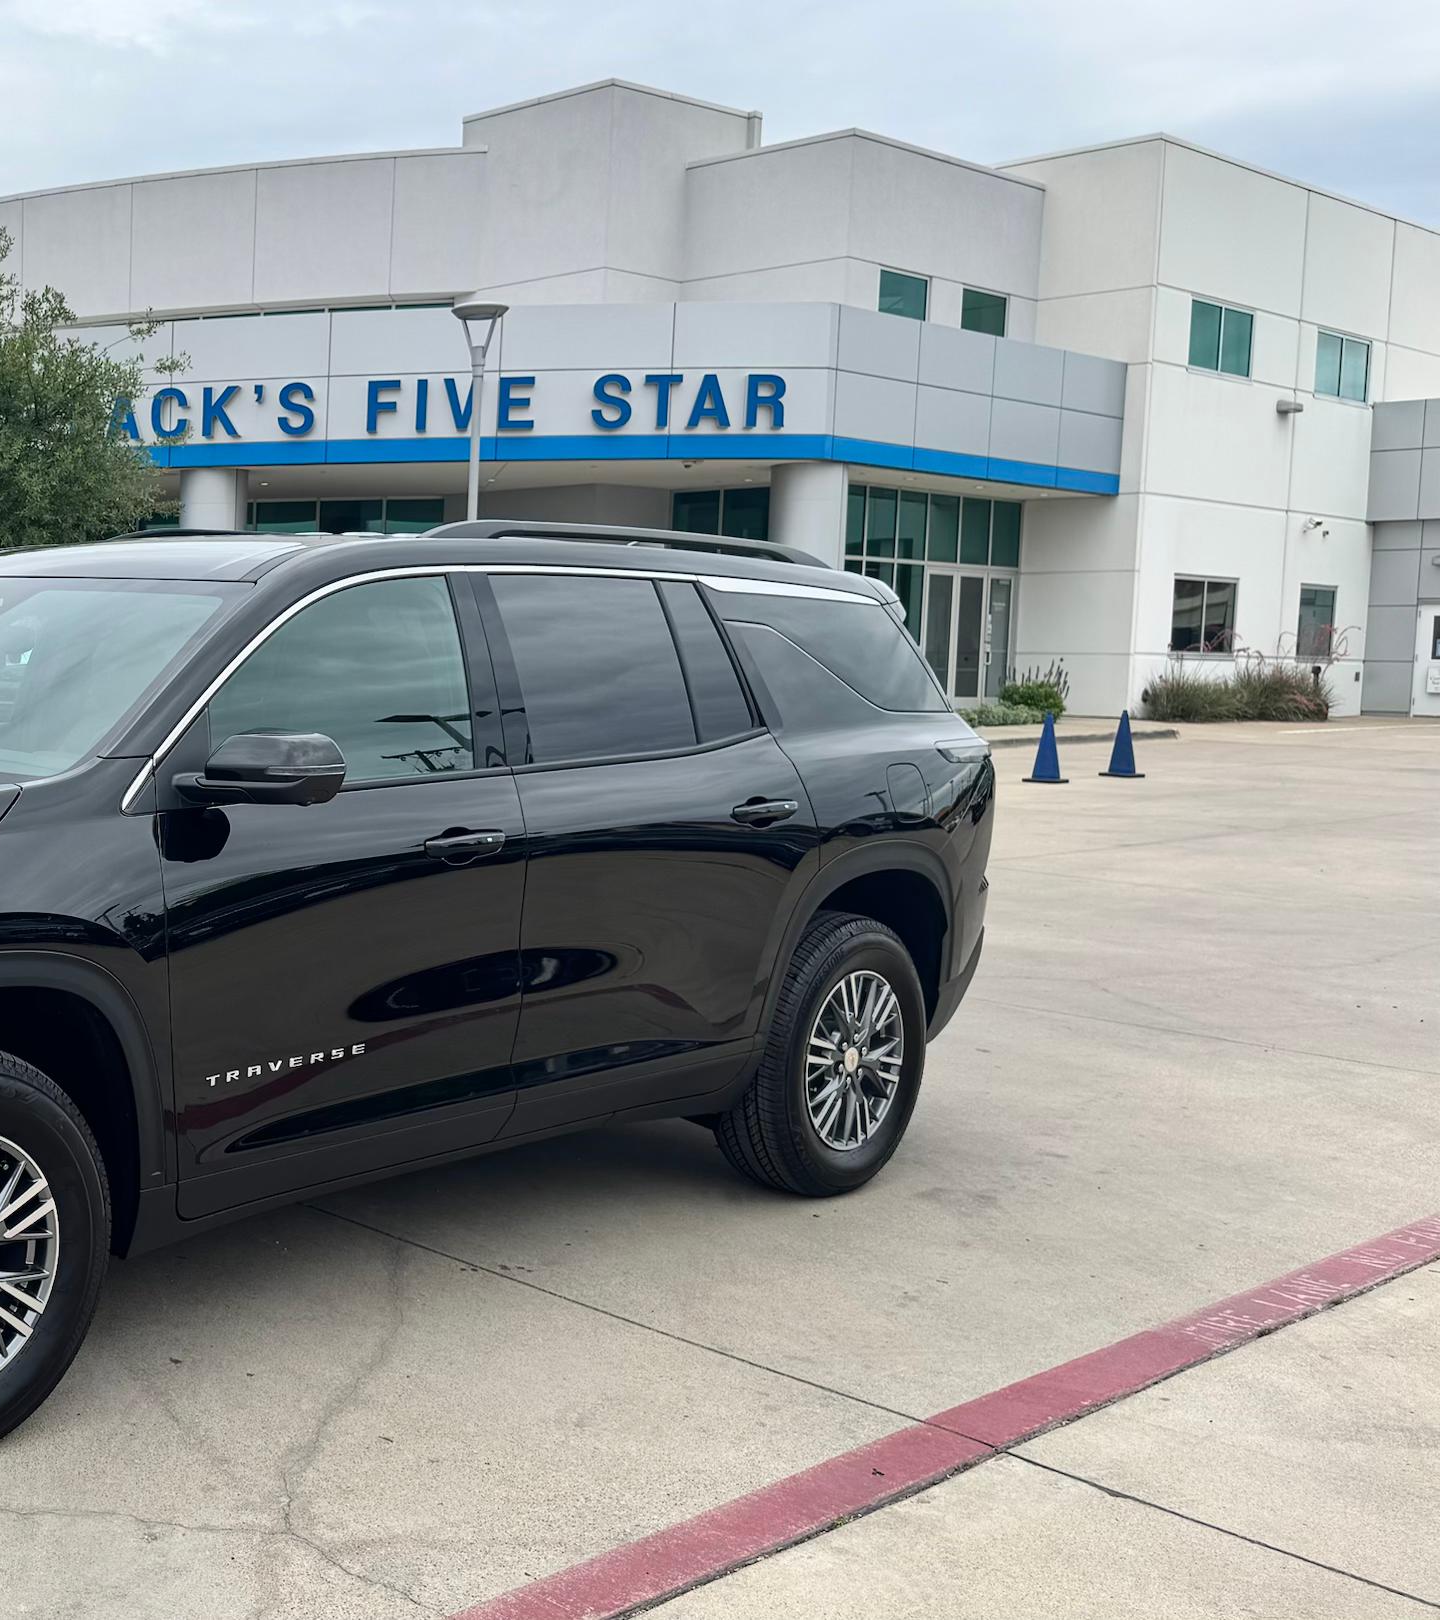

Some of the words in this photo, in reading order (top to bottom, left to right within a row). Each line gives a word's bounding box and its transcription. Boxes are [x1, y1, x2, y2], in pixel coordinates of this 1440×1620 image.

[107, 382, 317, 441] ACK'S
[366, 376, 536, 433] FIVE
[591, 374, 787, 430] STAR
[206, 1043, 366, 1087] TRAVERSE
